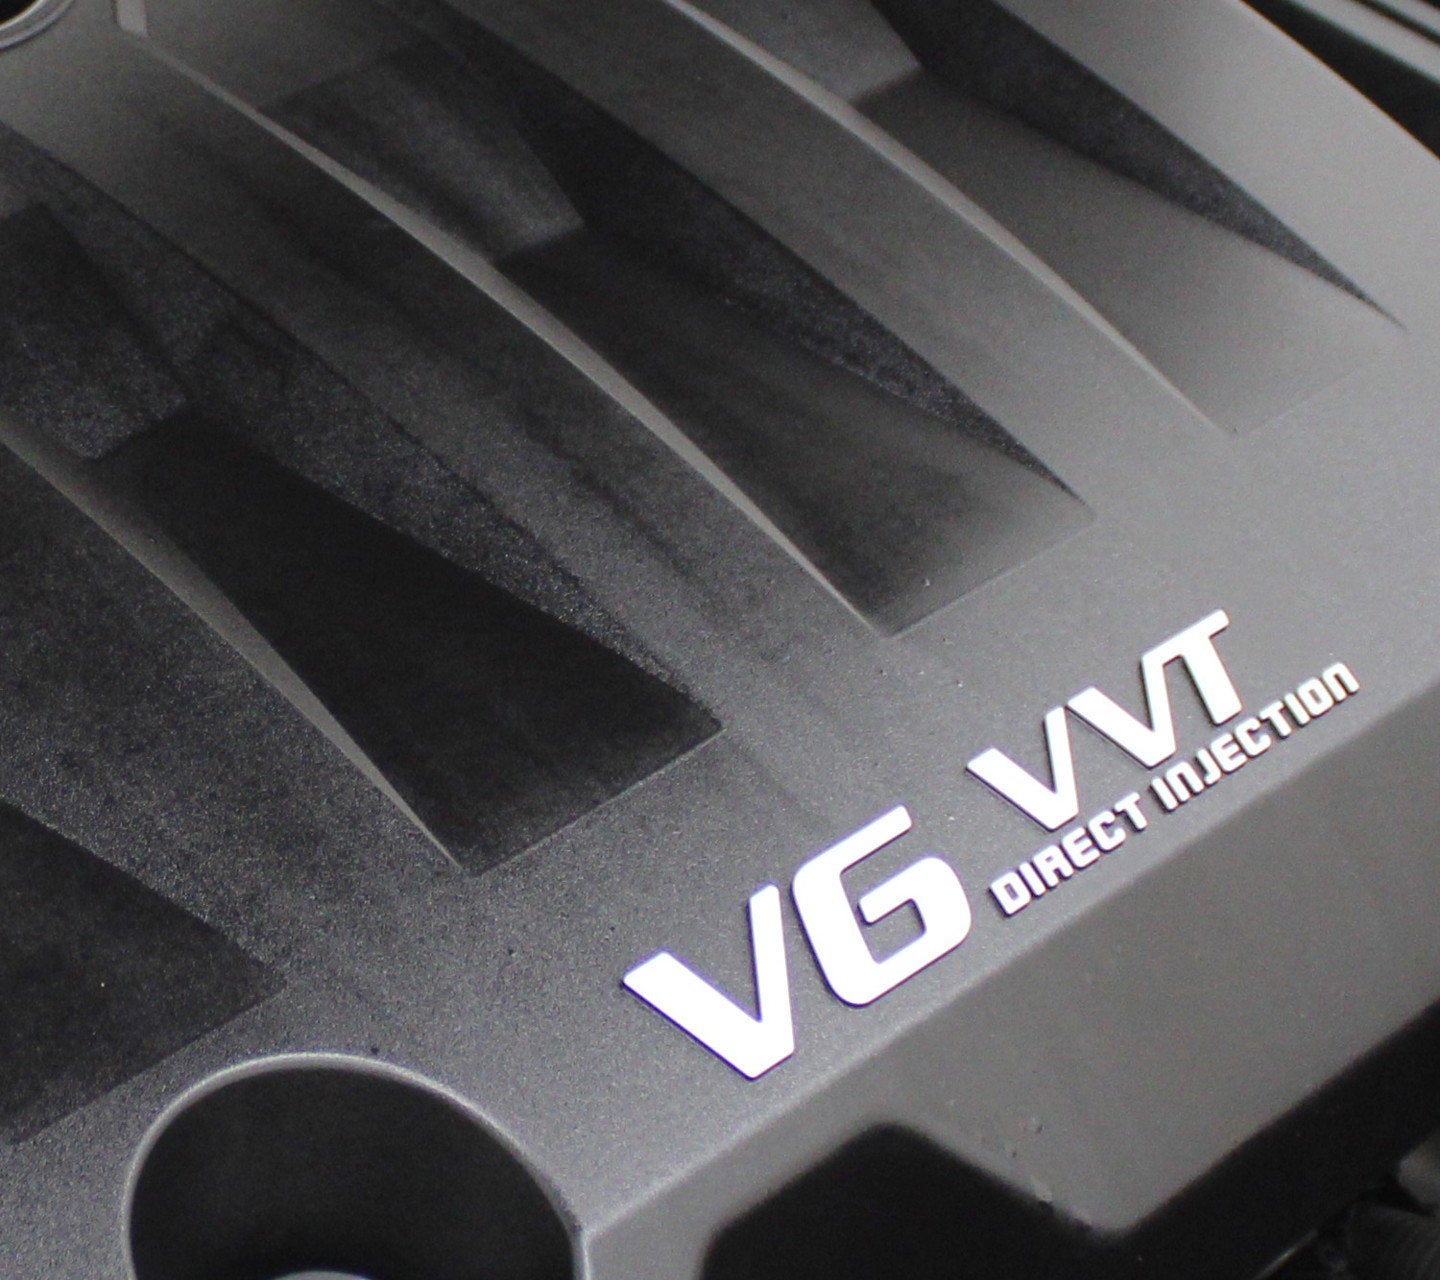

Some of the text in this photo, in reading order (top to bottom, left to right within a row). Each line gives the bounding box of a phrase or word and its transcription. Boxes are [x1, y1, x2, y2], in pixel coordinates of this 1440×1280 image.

[622, 608, 1243, 1081] V6 VVT
[989, 661, 1361, 917] DIRECT INJECTION
